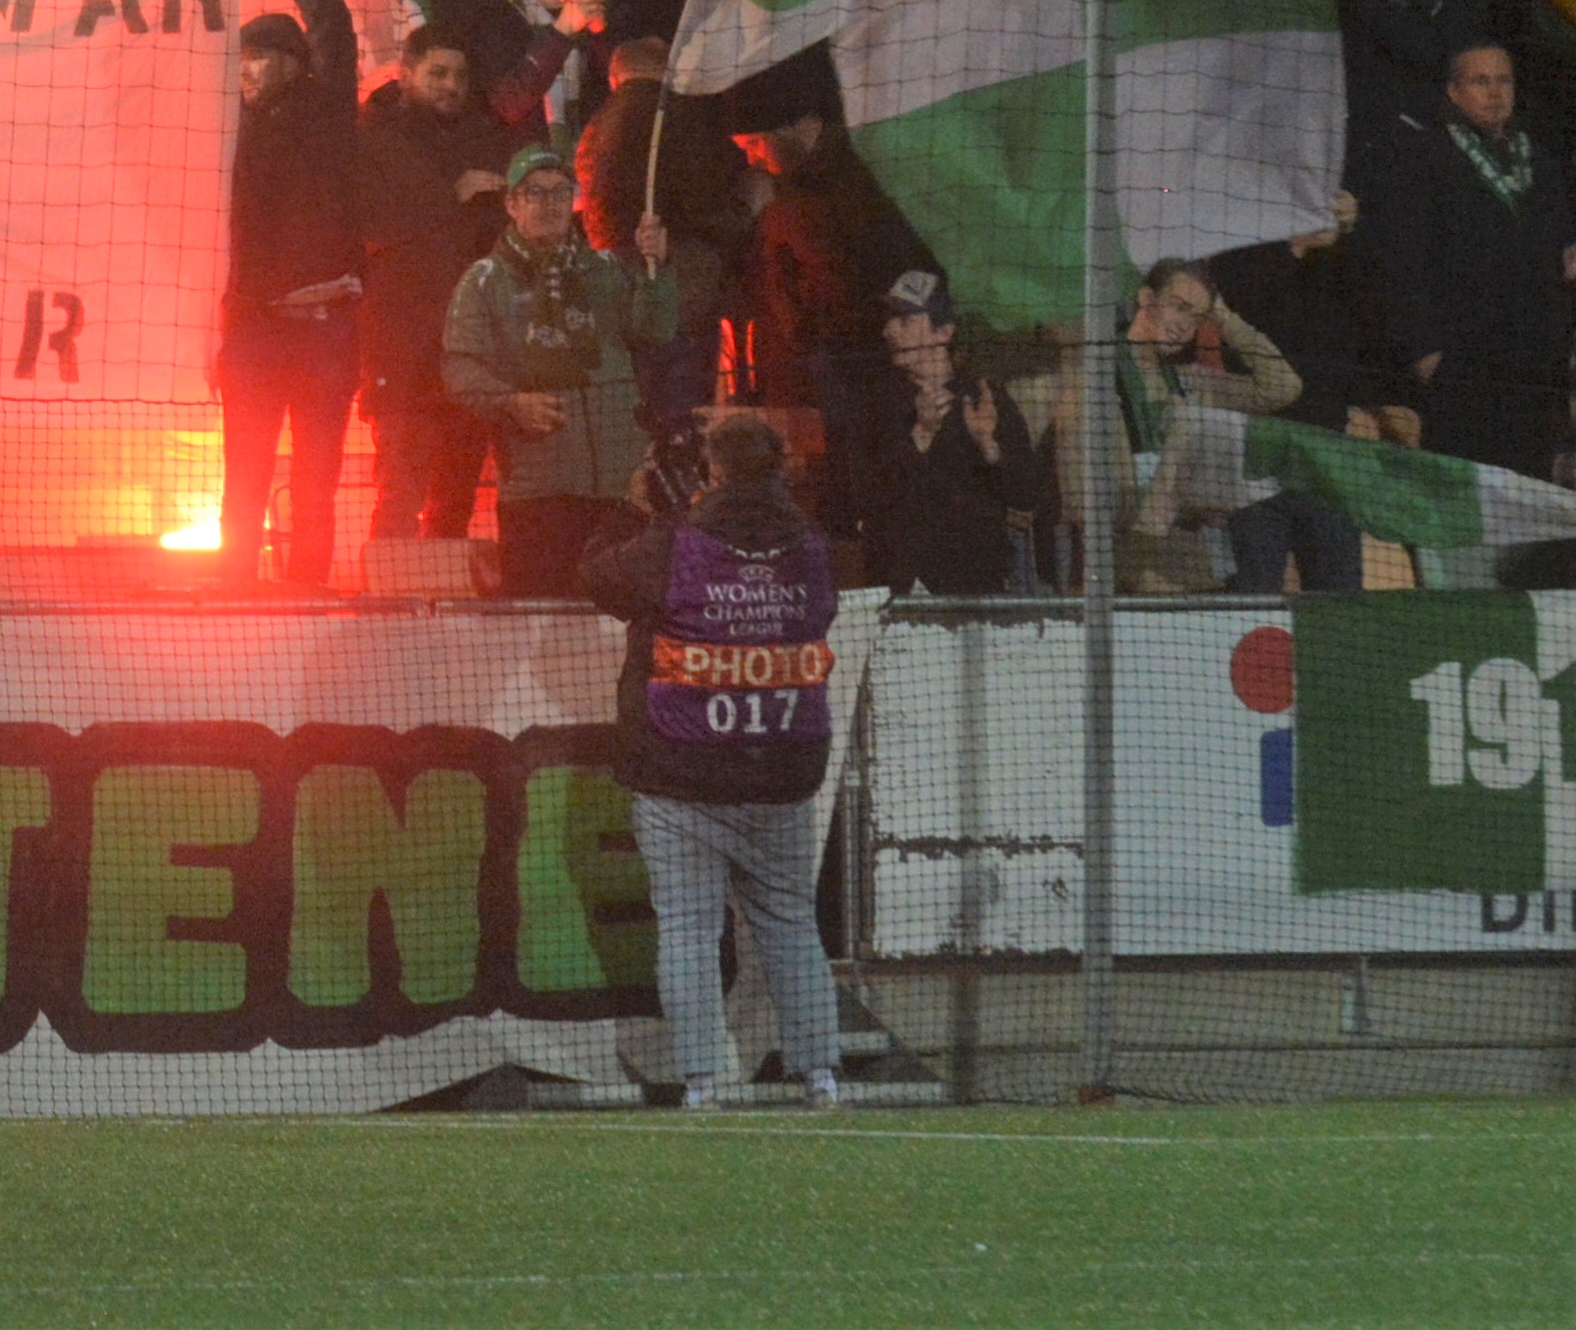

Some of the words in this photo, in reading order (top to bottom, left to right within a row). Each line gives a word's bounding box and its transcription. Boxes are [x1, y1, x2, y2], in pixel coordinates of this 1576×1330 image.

[706, 583, 808, 603] WOMEN'S
[703, 603, 805, 621] CHAMPIONS
[729, 622, 784, 636] LEAGUE
[684, 645, 824, 687] PHOTO
[706, 688, 799, 735] 017
